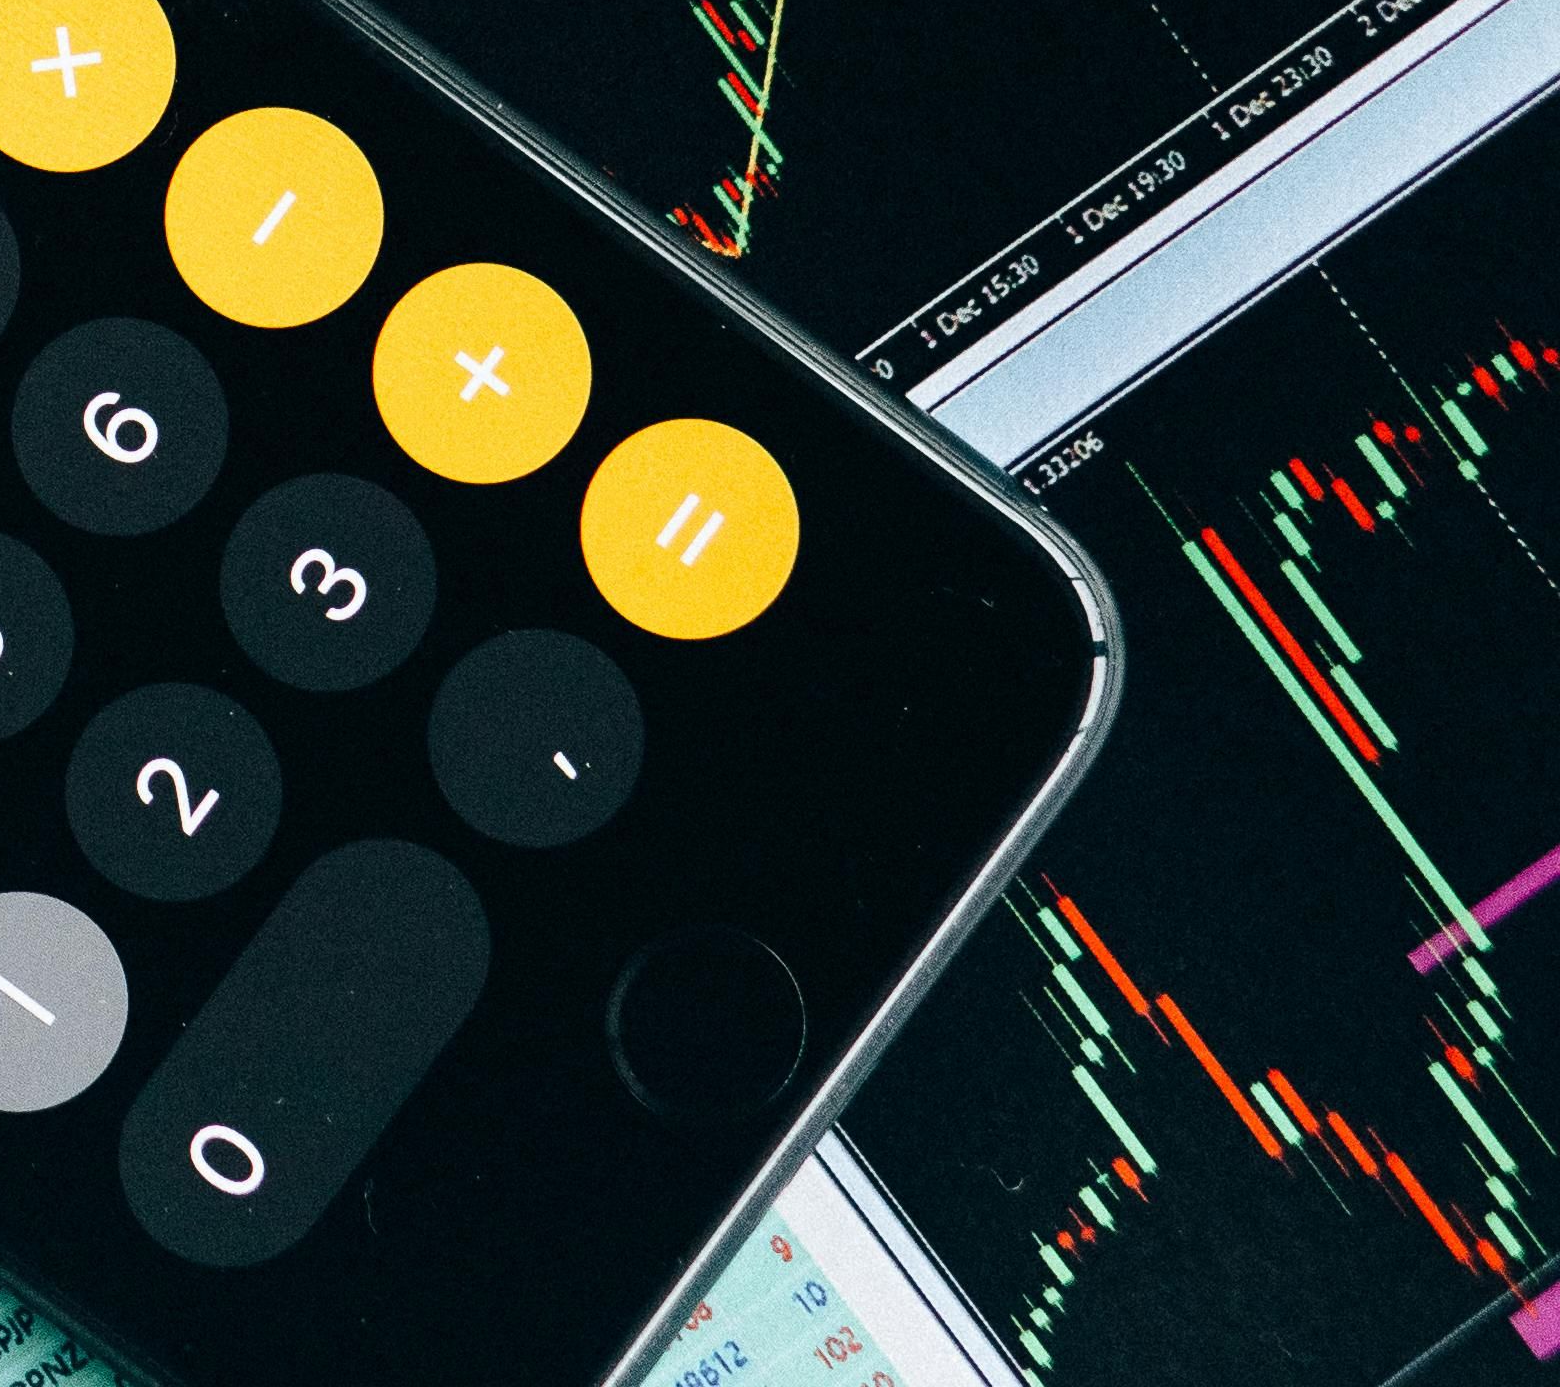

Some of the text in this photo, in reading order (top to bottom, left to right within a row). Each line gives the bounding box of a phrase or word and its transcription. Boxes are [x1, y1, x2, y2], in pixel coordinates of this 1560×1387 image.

[1357, 14, 1378, 37] 2
[1212, 45, 1334, 141] 1 Dec 23:30
[1065, 150, 1187, 246] 1 Dec 19:30
[919, 253, 1041, 350] 1 Dec 15:30
[84, 392, 158, 463] 6
[291, 549, 366, 620] 3
[137, 758, 219, 836] 2
[190, 1125, 264, 1195] 0
[770, 1233, 794, 1262] 9
[792, 1279, 829, 1315] 10
[814, 1325, 863, 1371] 102
